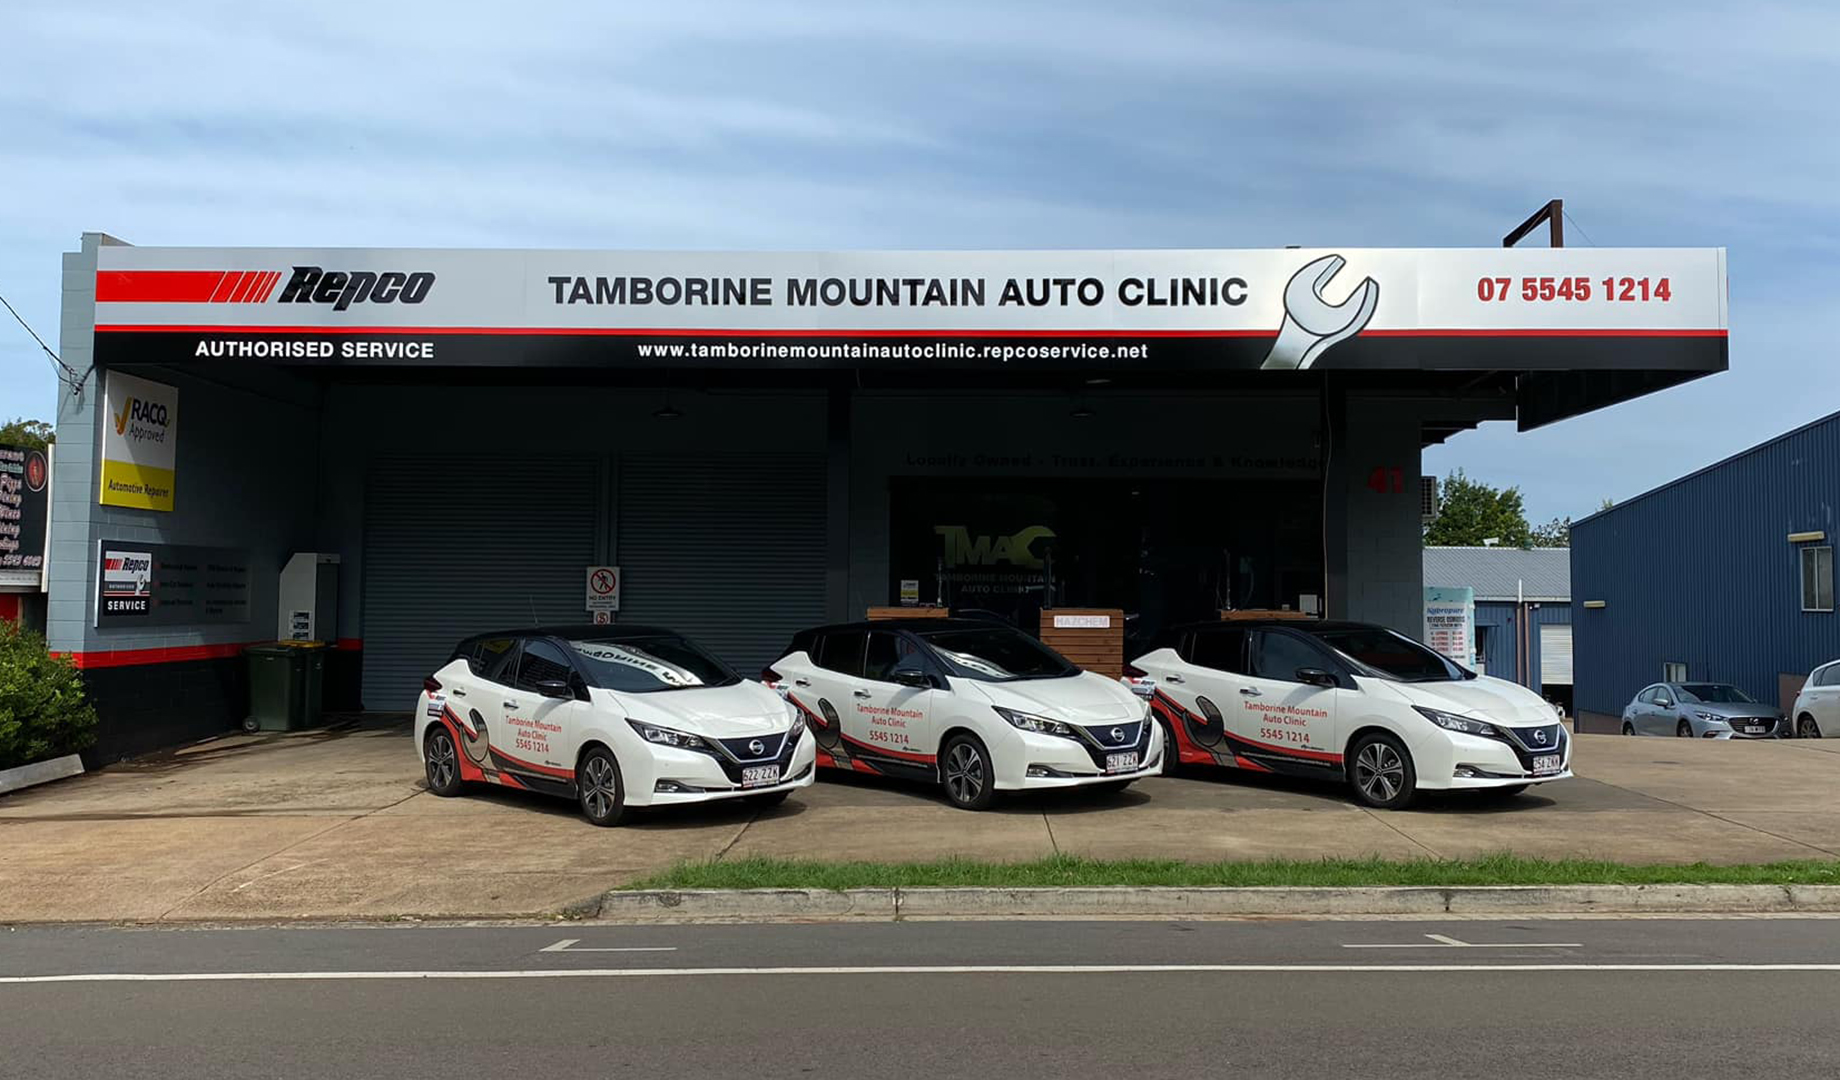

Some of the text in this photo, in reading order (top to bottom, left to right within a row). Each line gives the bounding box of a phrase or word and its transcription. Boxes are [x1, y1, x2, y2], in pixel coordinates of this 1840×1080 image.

[277, 266, 436, 311] Repco
[548, 276, 1249, 307] TAMBORINE MOUNTAIN AUTO CLINIC
[1477, 276, 1672, 302] 07 5545 1214
[195, 341, 435, 359] AUTHORISED SERVICE
[637, 341, 1149, 361] www.tamborinemountainautoclinic.repcoservice.net
[131, 398, 168, 428] RACQ
[129, 423, 165, 443] Approved
[109, 478, 143, 494] Automotive
[1367, 465, 1404, 494] 41
[122, 557, 150, 574] Repco
[107, 599, 147, 611] SERVICE
[1056, 617, 1108, 626] HAZCHEM
[857, 703, 923, 719] Tamborine Mountain
[1244, 701, 1328, 718] Tamborine Mountain
[505, 715, 562, 733] Tamborine Mountain
[872, 716, 906, 728] Auto Clinic
[1263, 714, 1307, 727] Auto Clinic
[517, 728, 547, 741] Auto Clinic
[870, 730, 909, 744] 5545 1214
[1260, 728, 1310, 743] 5545 1214
[516, 739, 549, 752] 5545 1214
